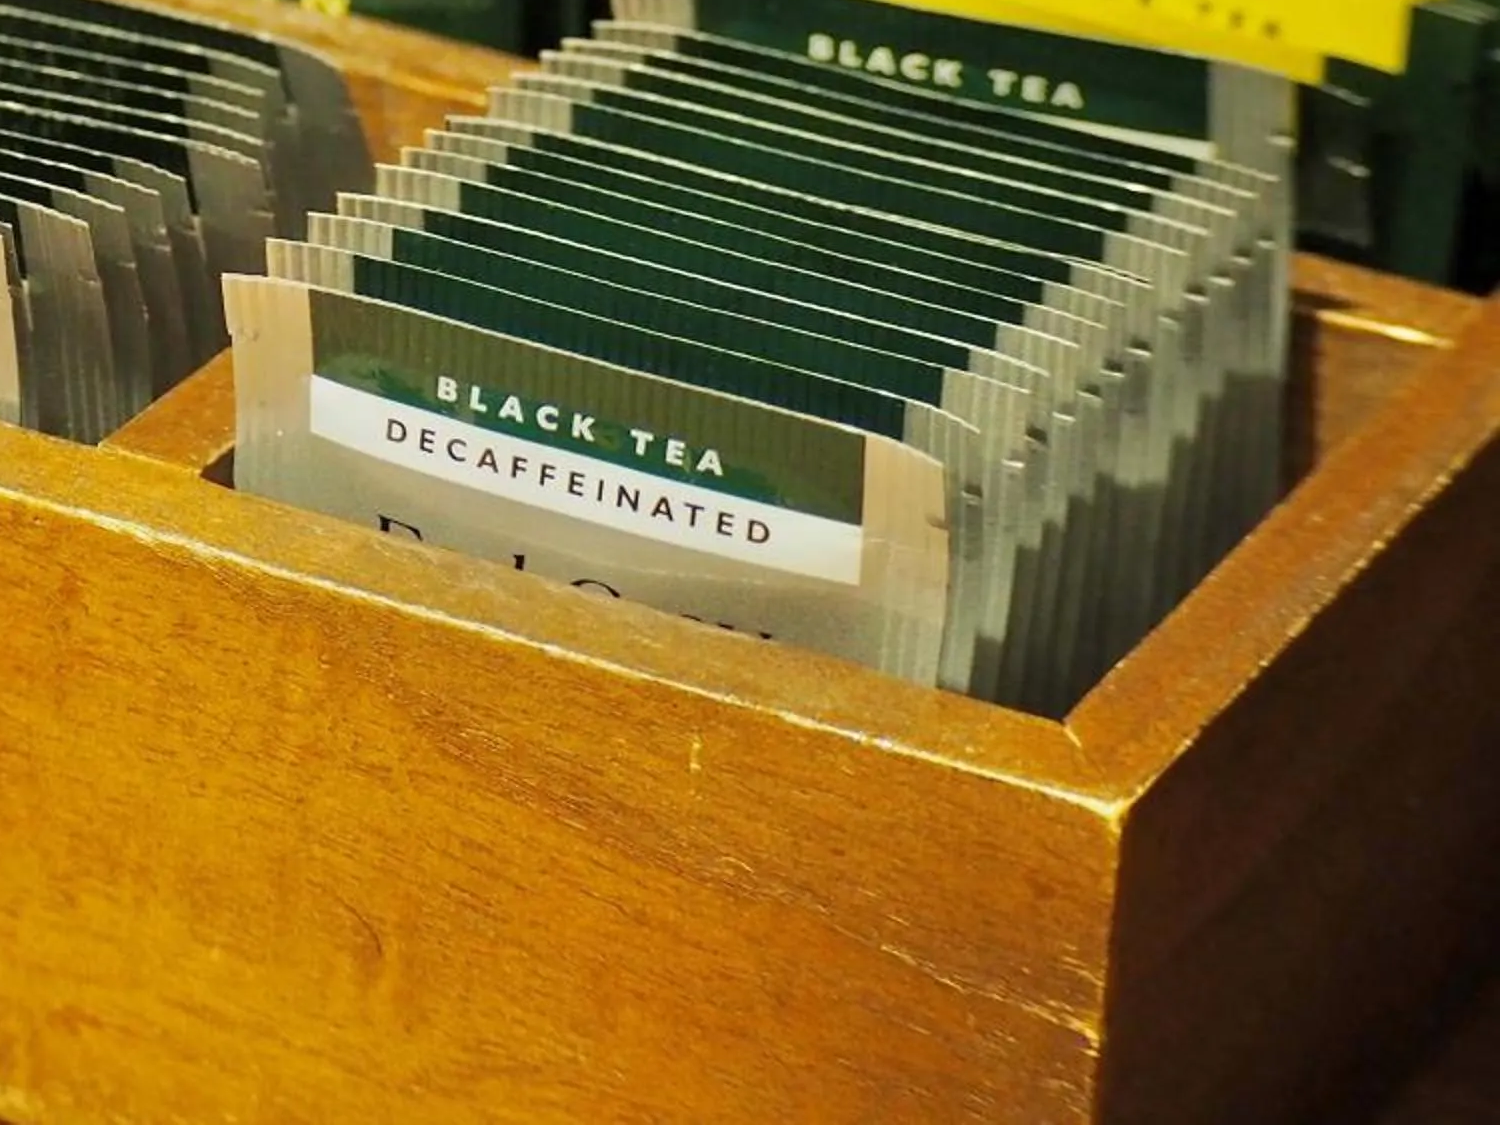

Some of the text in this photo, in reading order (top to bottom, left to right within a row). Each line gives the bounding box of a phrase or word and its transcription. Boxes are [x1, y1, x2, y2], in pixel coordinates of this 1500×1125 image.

[806, 32, 1085, 111] BLACK TEA
[436, 375, 725, 477] BLACK TEA
[386, 418, 772, 545] DECAFFEINATED
